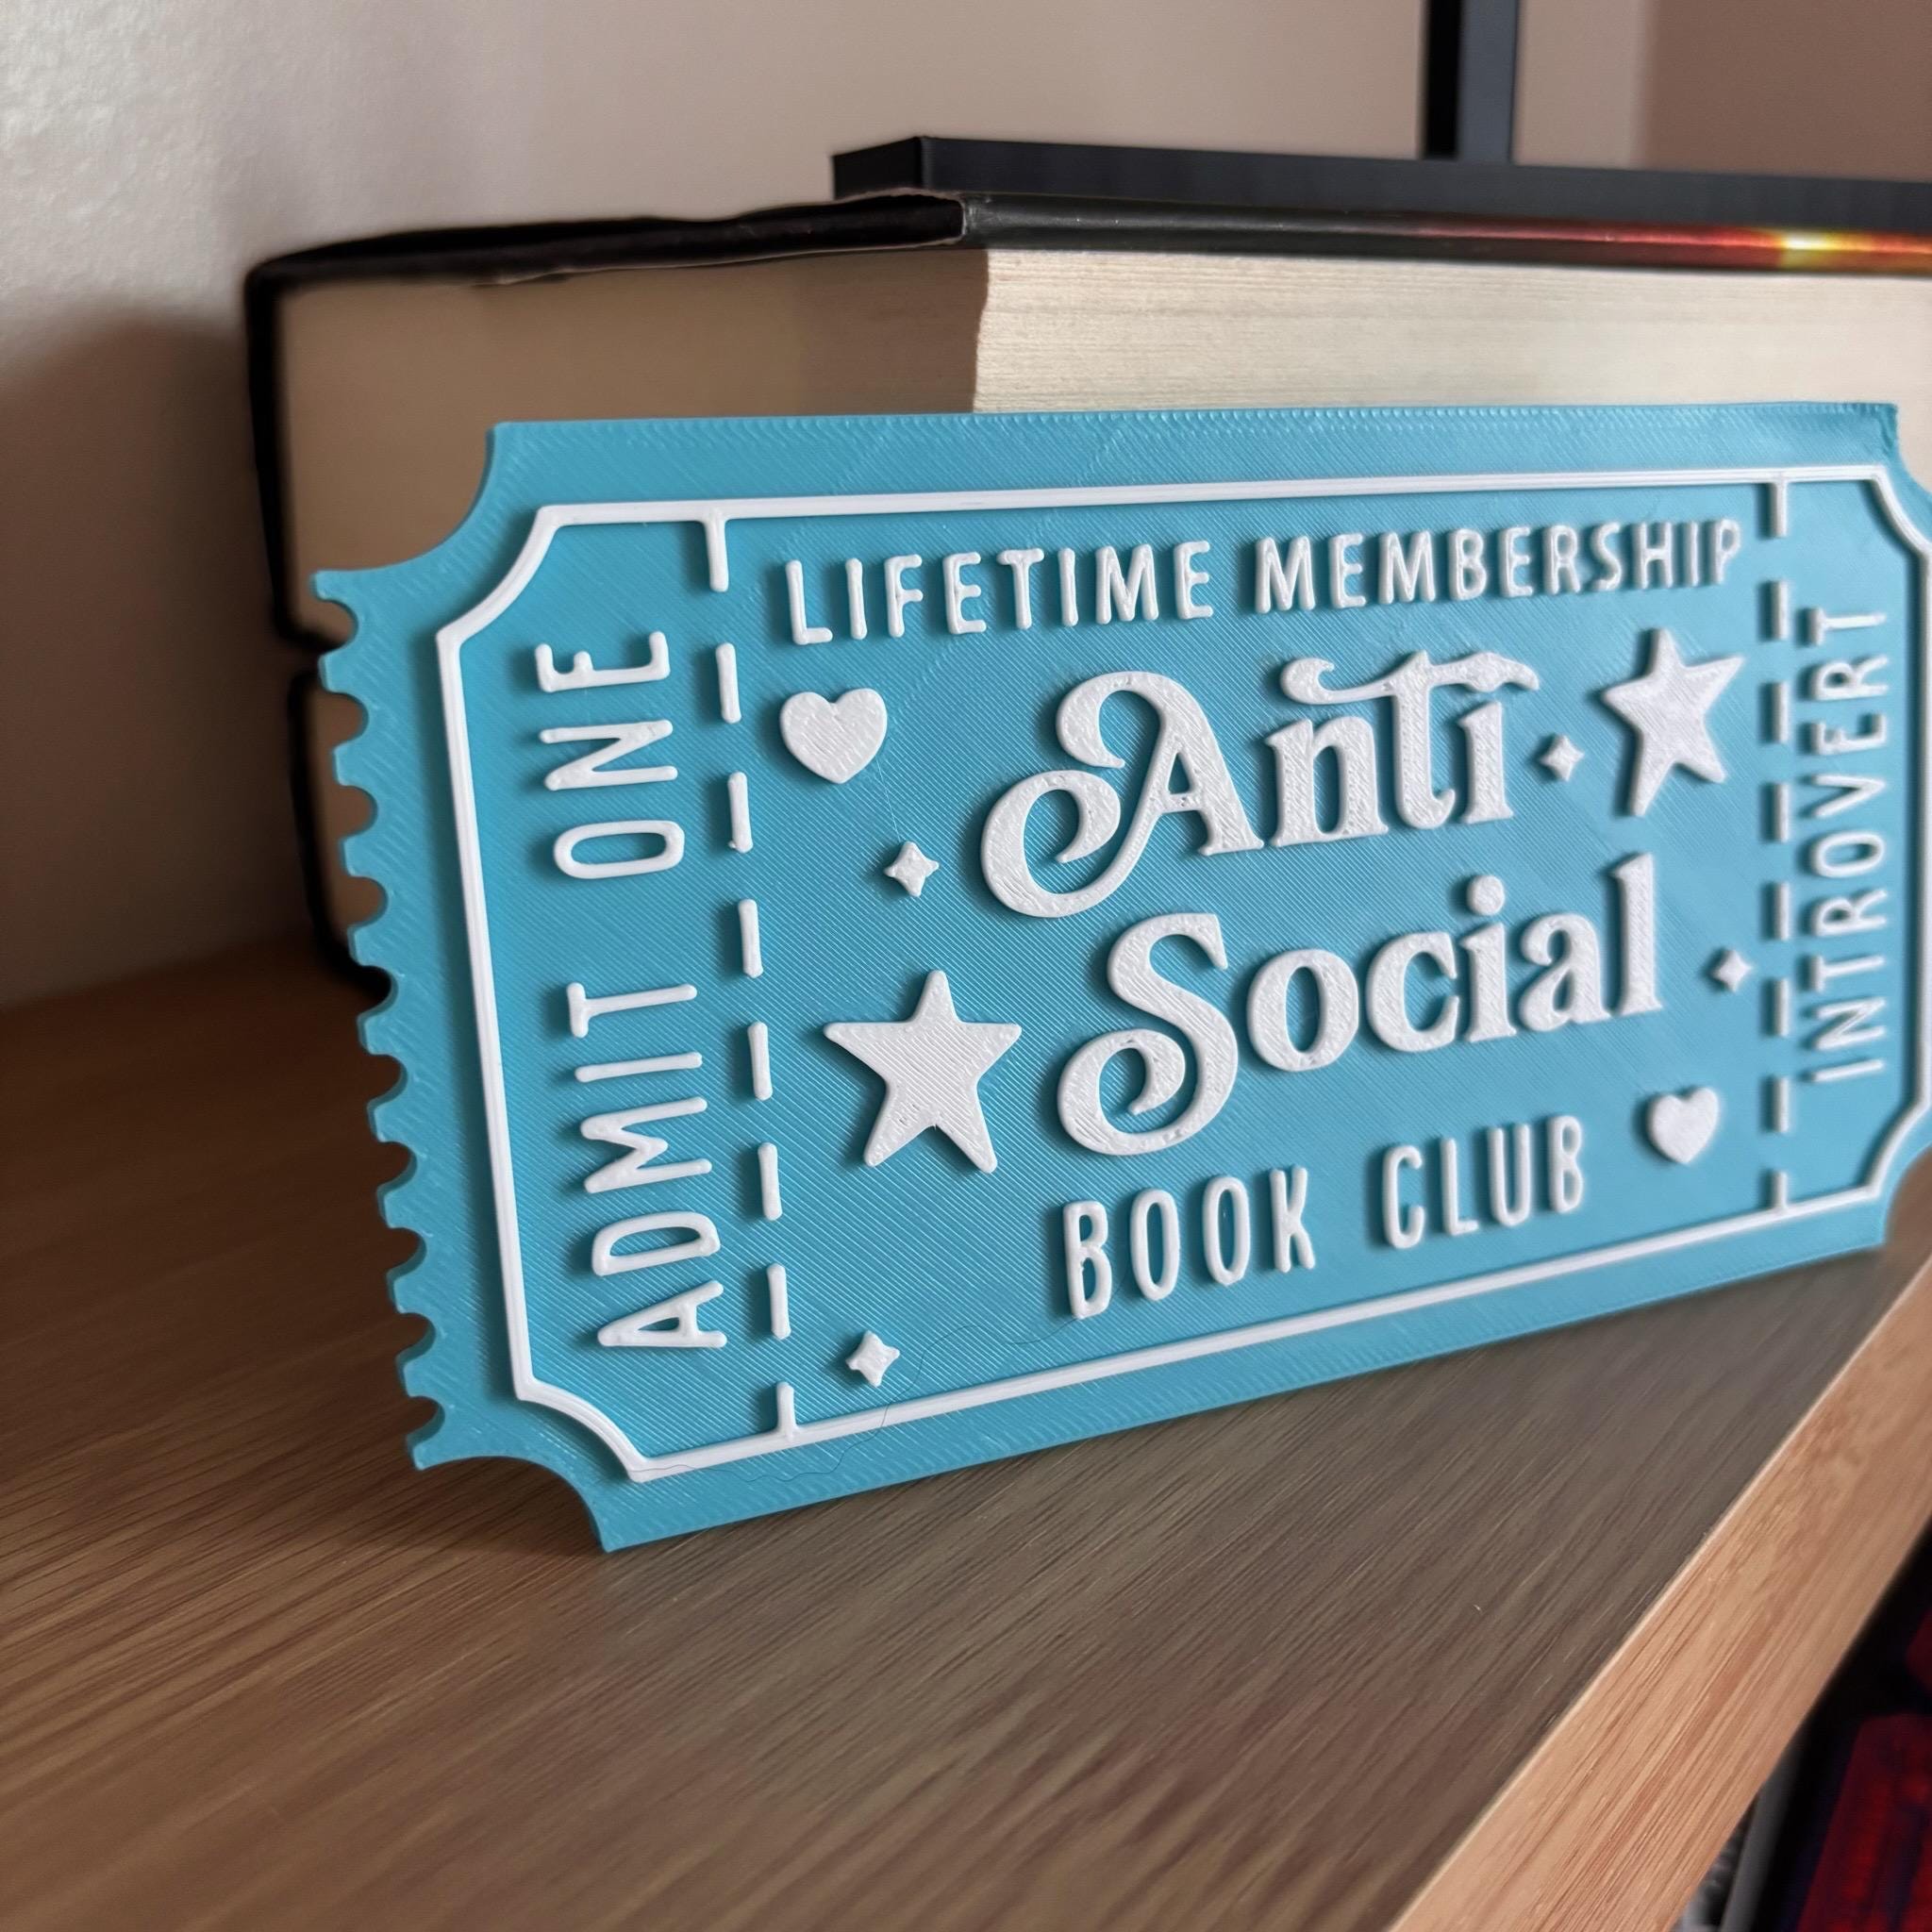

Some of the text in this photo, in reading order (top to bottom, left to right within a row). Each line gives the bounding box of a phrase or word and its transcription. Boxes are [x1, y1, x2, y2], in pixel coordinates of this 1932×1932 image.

[786, 516, 1744, 645] LIFETIME MEMBERSHIP
[982, 648, 1541, 919] Anti
[1800, 606, 1890, 1085] INTROVERT
[534, 631, 728, 1349] ADMIT ONE
[1058, 851, 1664, 1158] Social
[1063, 1115, 1586, 1320] BOOK CLUB
